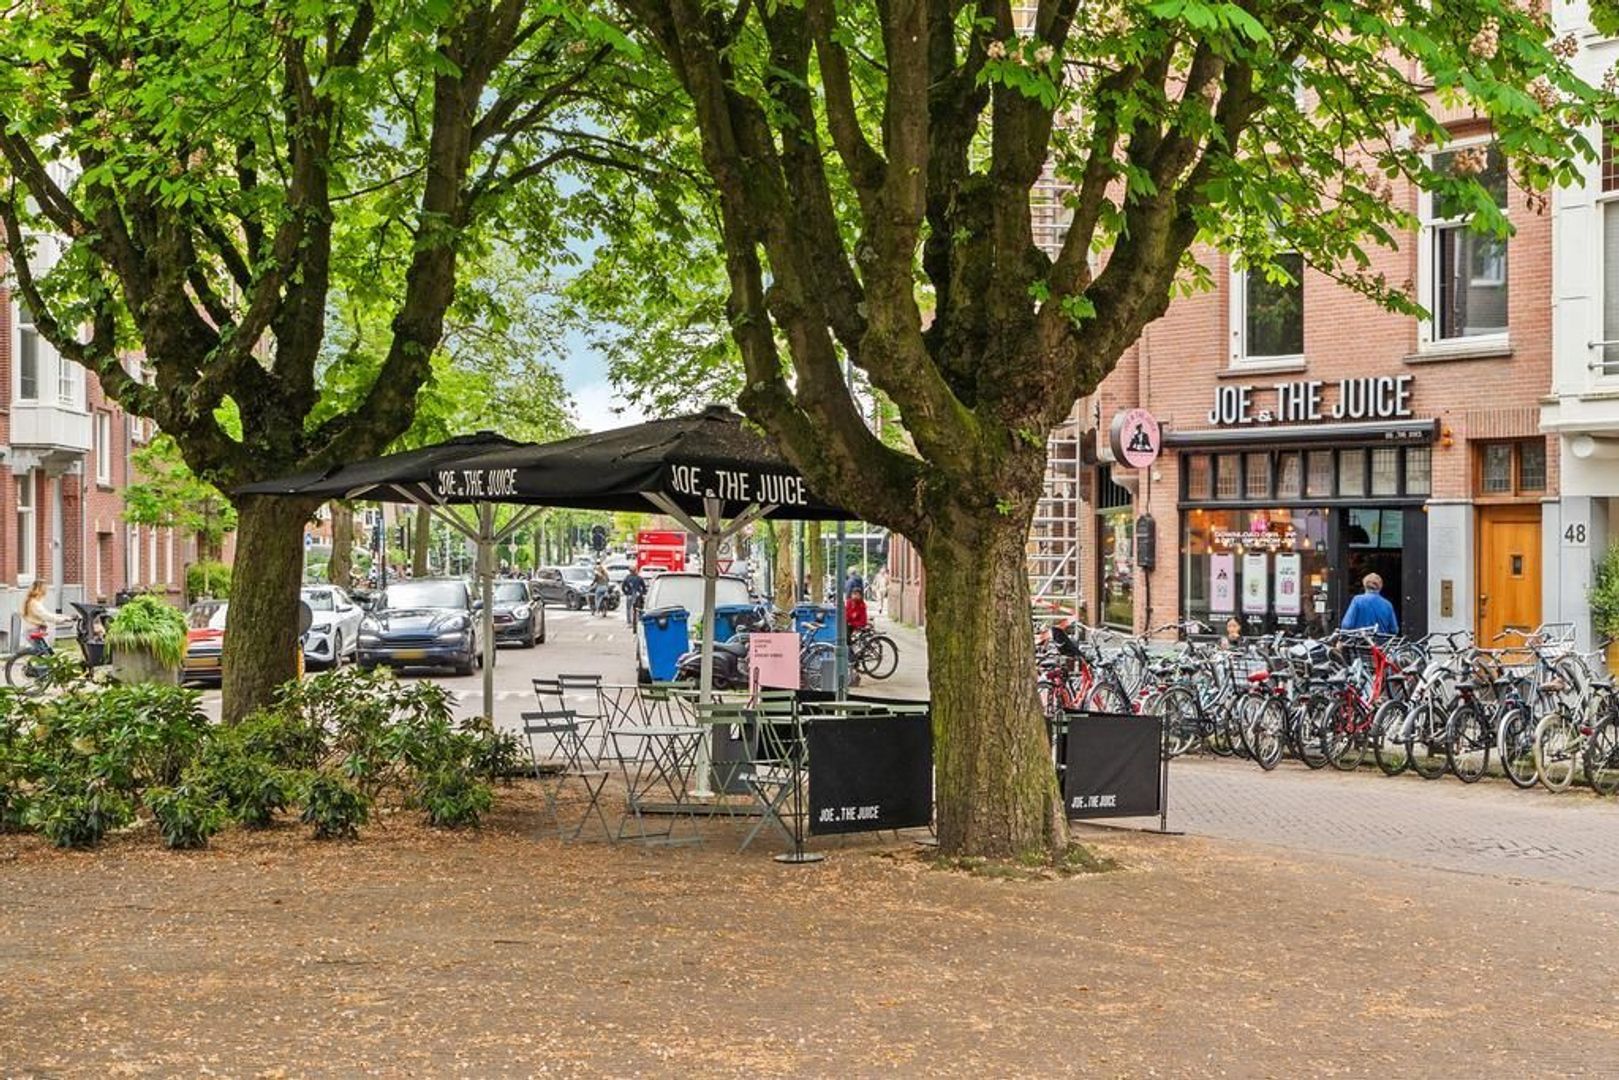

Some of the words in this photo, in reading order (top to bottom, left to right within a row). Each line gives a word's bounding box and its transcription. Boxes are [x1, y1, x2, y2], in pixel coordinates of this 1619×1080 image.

[1208, 386, 1253, 425] JOE
[1258, 410, 1273, 423] &
[1273, 381, 1323, 422] THE
[1332, 375, 1413, 420] JUICE
[438, 470, 456, 495] JOE
[463, 469, 485, 496] THE
[487, 468, 518, 496] JUICE
[671, 464, 702, 496] JOE
[705, 488, 716, 498] &
[715, 470, 751, 501] THE
[756, 474, 808, 505] JUICE
[1564, 523, 1586, 544] 48
[819, 807, 834, 822] JOE
[841, 806, 857, 821] THE
